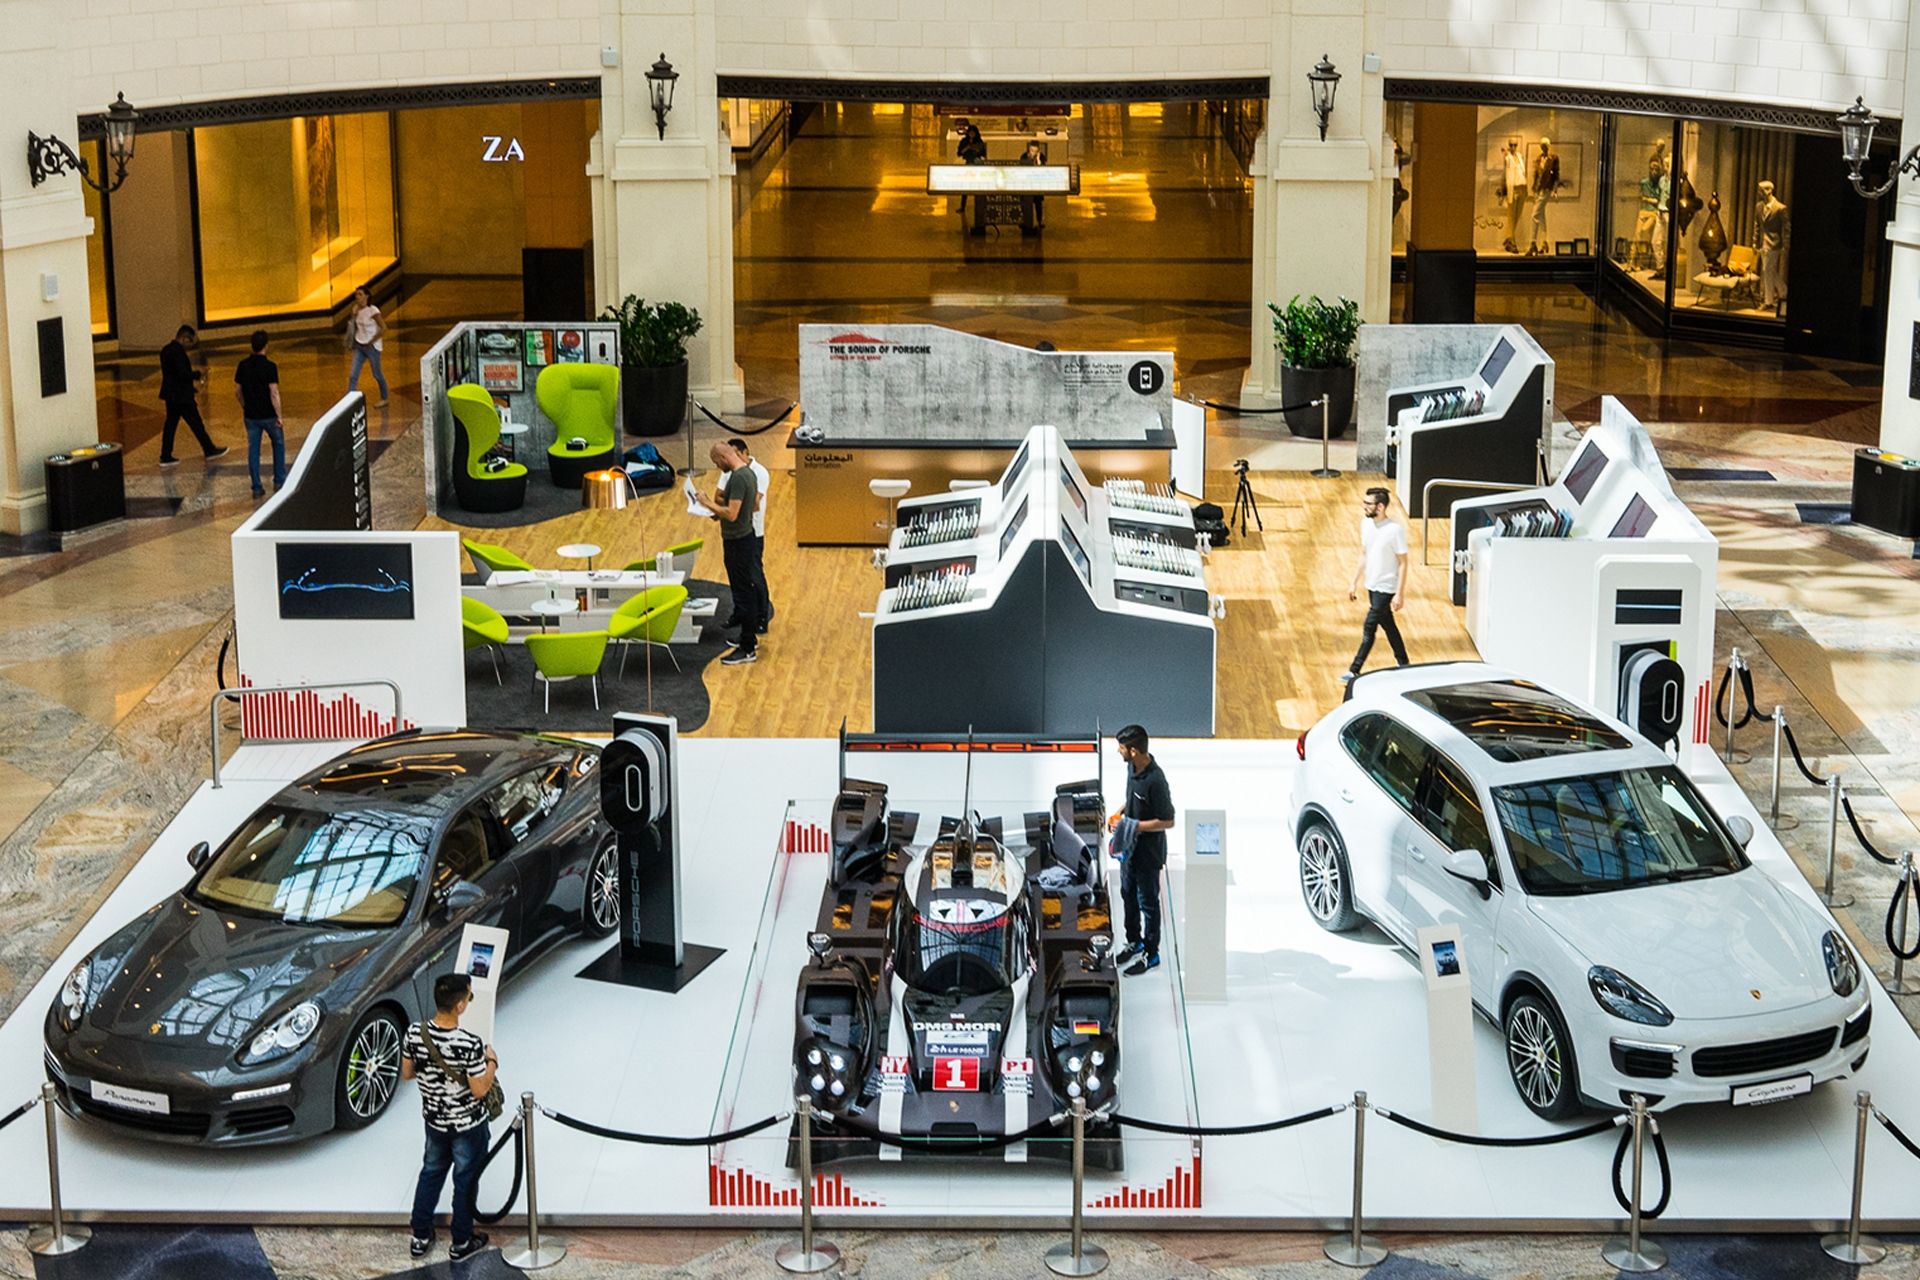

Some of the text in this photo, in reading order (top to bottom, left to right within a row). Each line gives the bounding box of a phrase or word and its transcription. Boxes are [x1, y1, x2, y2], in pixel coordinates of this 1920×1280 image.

[829, 345, 931, 355] THE SOUND OF PORSCHE
[630, 851, 641, 948] PORSCHE
[913, 1022, 1001, 1032] DMG MORI
[881, 1056, 908, 1073] HY
[1006, 1061, 1027, 1072] P1
[946, 1059, 966, 1088] 1
